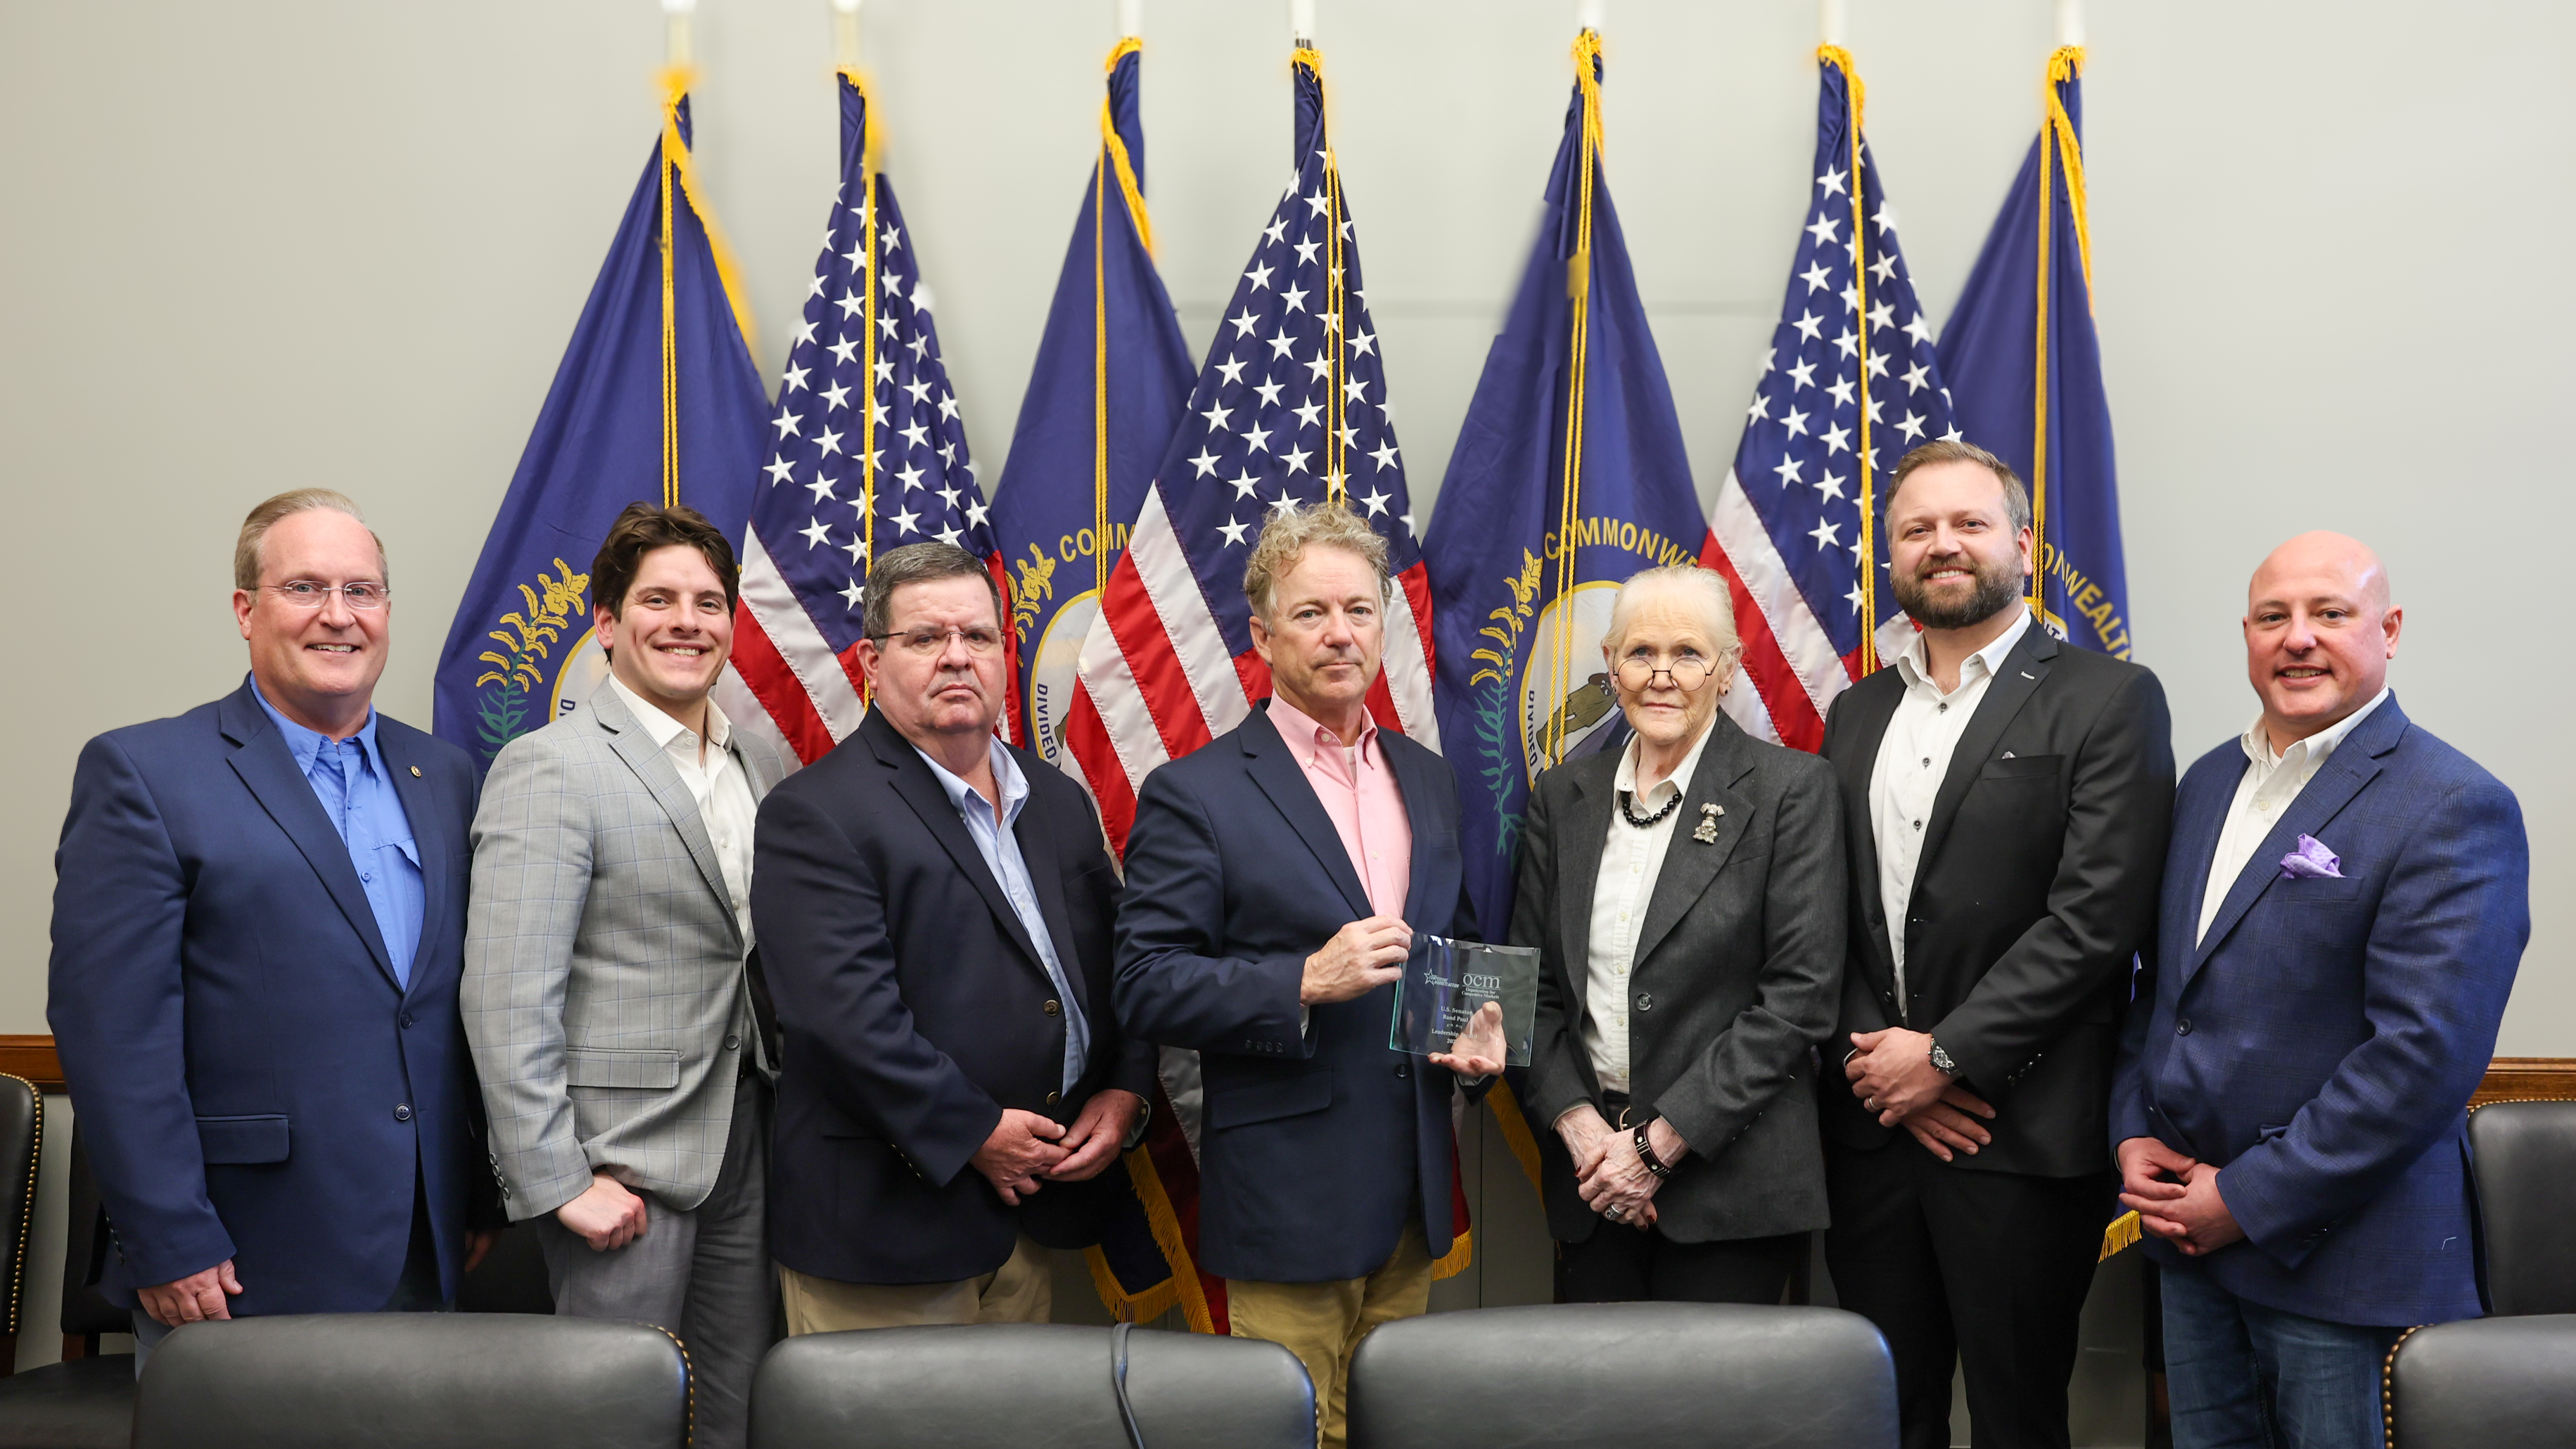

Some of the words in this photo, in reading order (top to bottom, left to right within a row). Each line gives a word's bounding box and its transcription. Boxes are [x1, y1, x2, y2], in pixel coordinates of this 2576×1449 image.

[1036, 682, 1057, 760] DIVIDED
[1527, 690, 1538, 767] DIVIDED
[1462, 974, 1500, 989] ocm
[1432, 1028, 1459, 1038] Leadership
